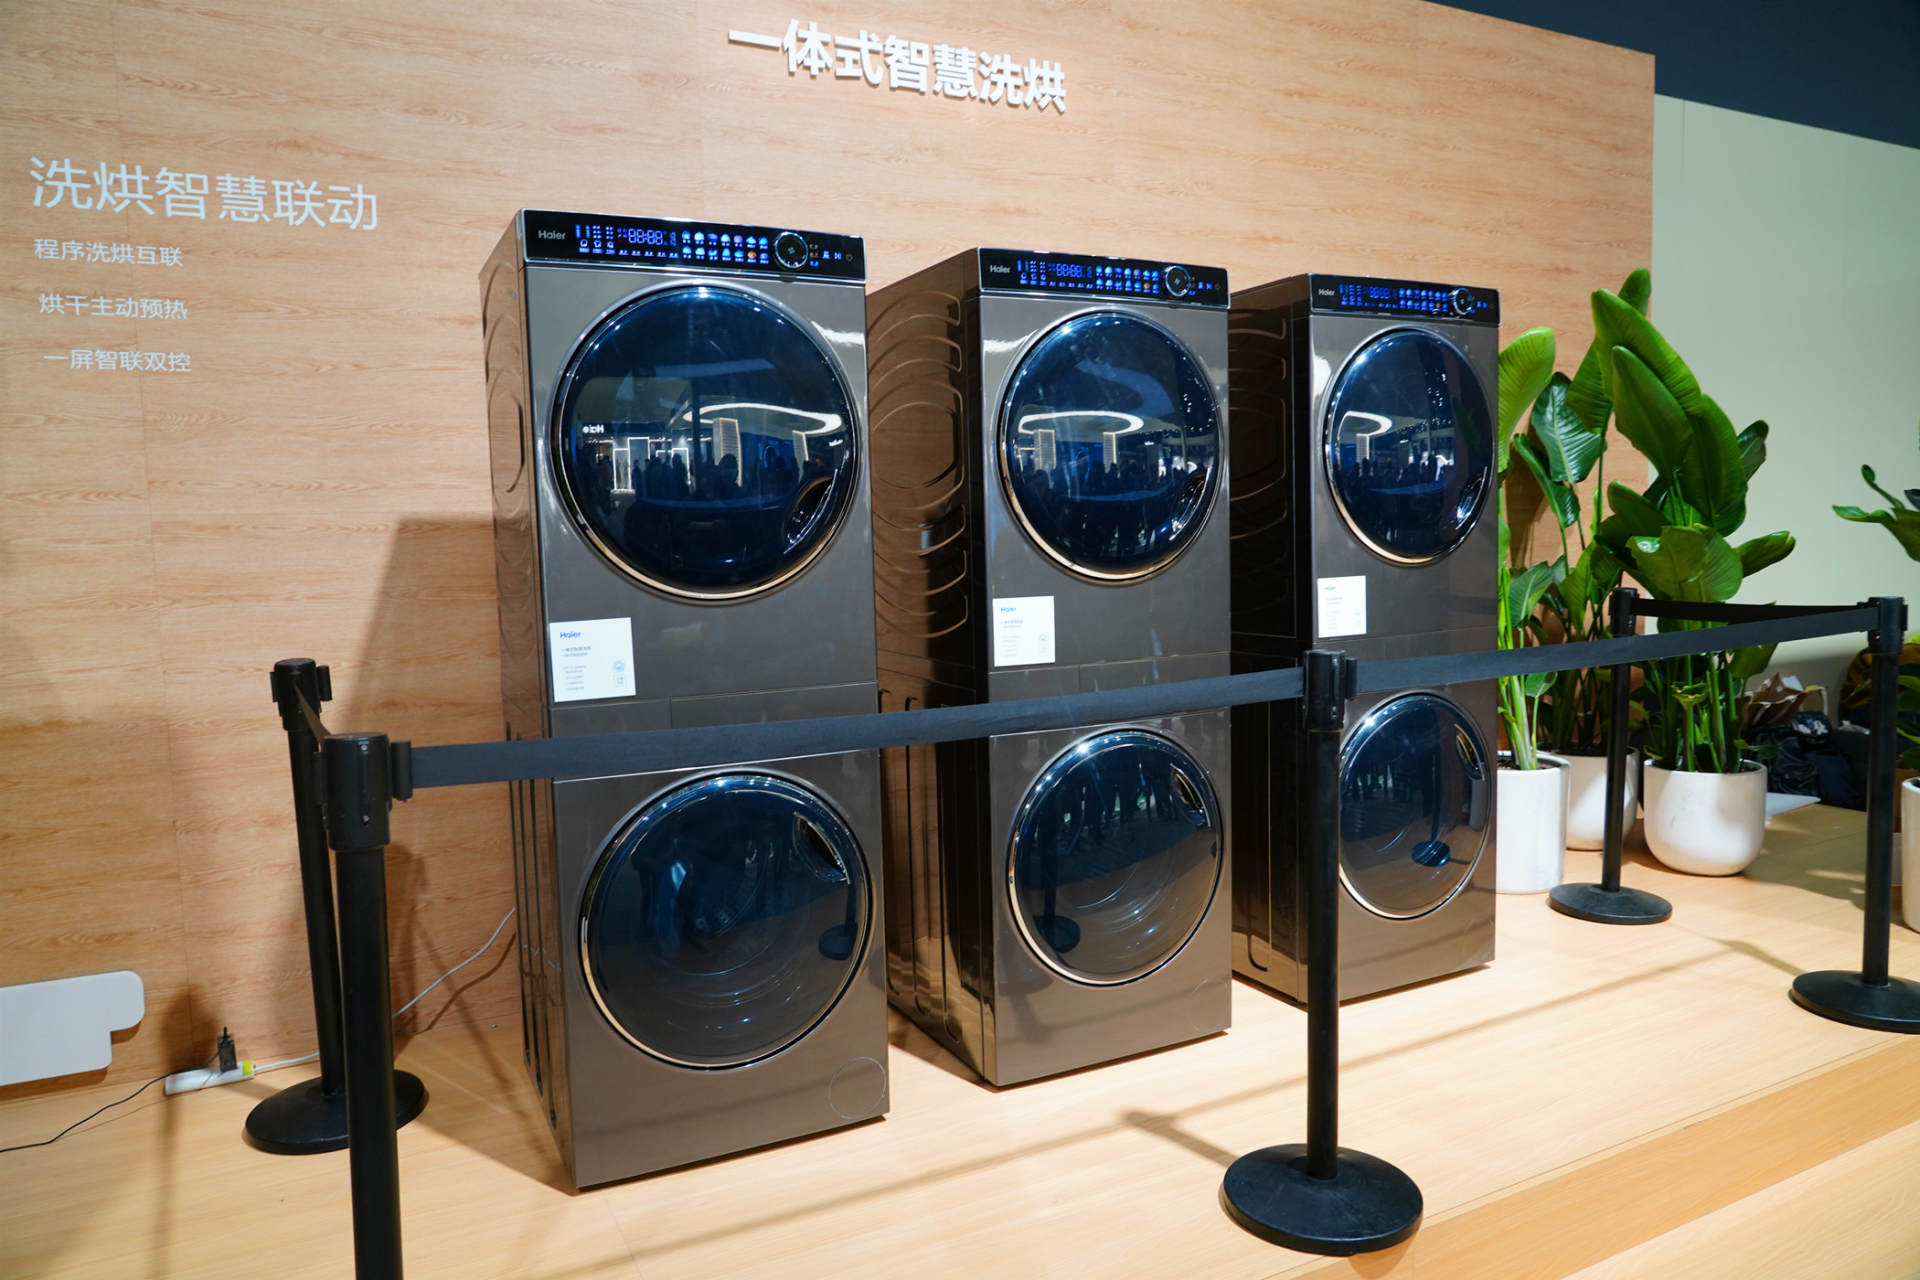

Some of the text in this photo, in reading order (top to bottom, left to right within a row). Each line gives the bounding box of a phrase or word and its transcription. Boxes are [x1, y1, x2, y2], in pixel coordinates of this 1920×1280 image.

[728, 18, 1067, 114] 一体式智慧洗烘
[29, 156, 378, 231] 洗烘智慧联动
[538, 229, 566, 240] Haier
[33, 238, 184, 267] 程序洗烘互联
[989, 264, 1011, 274] Haier
[38, 292, 189, 320] 烘干主动预热
[43, 348, 193, 373] 一屏智联双控
